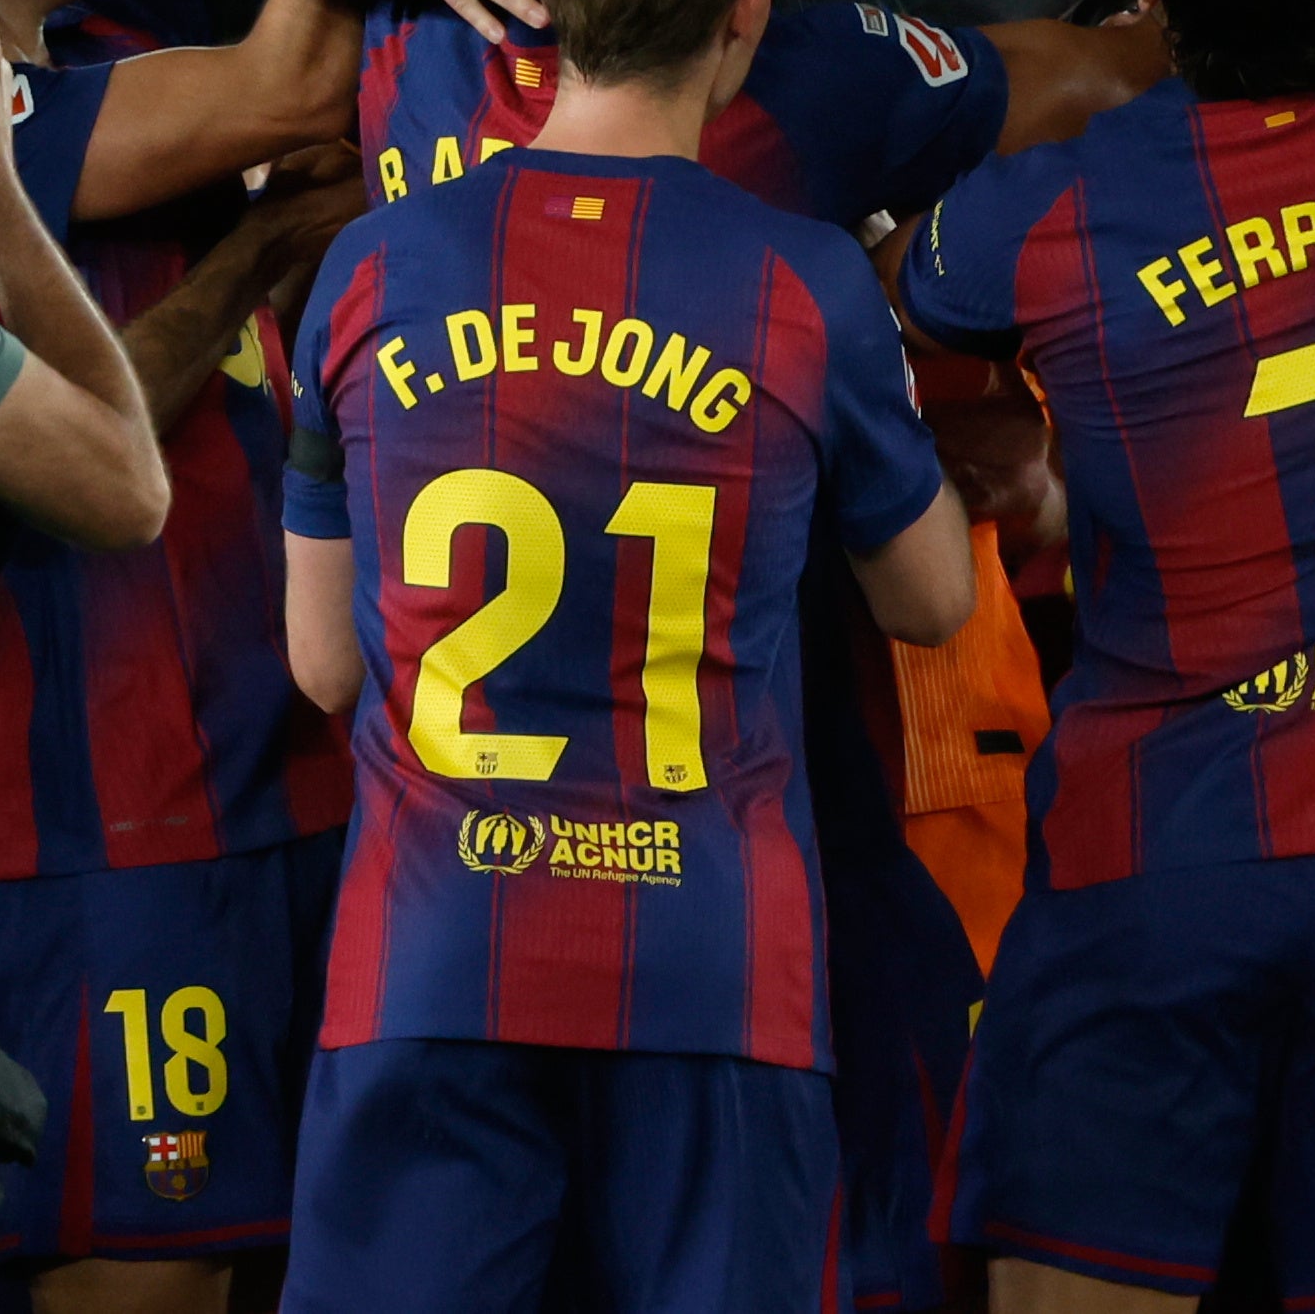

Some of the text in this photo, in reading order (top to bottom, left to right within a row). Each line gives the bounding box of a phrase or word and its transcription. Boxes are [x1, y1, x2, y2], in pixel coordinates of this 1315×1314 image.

[376, 303, 753, 435] F. DE JONG
[402, 468, 719, 793] 21
[548, 838, 682, 874] ACNUR
[550, 814, 680, 848] UNHCR
[551, 867, 682, 887] The UN Refugee Agency
[103, 985, 229, 1123] 18
